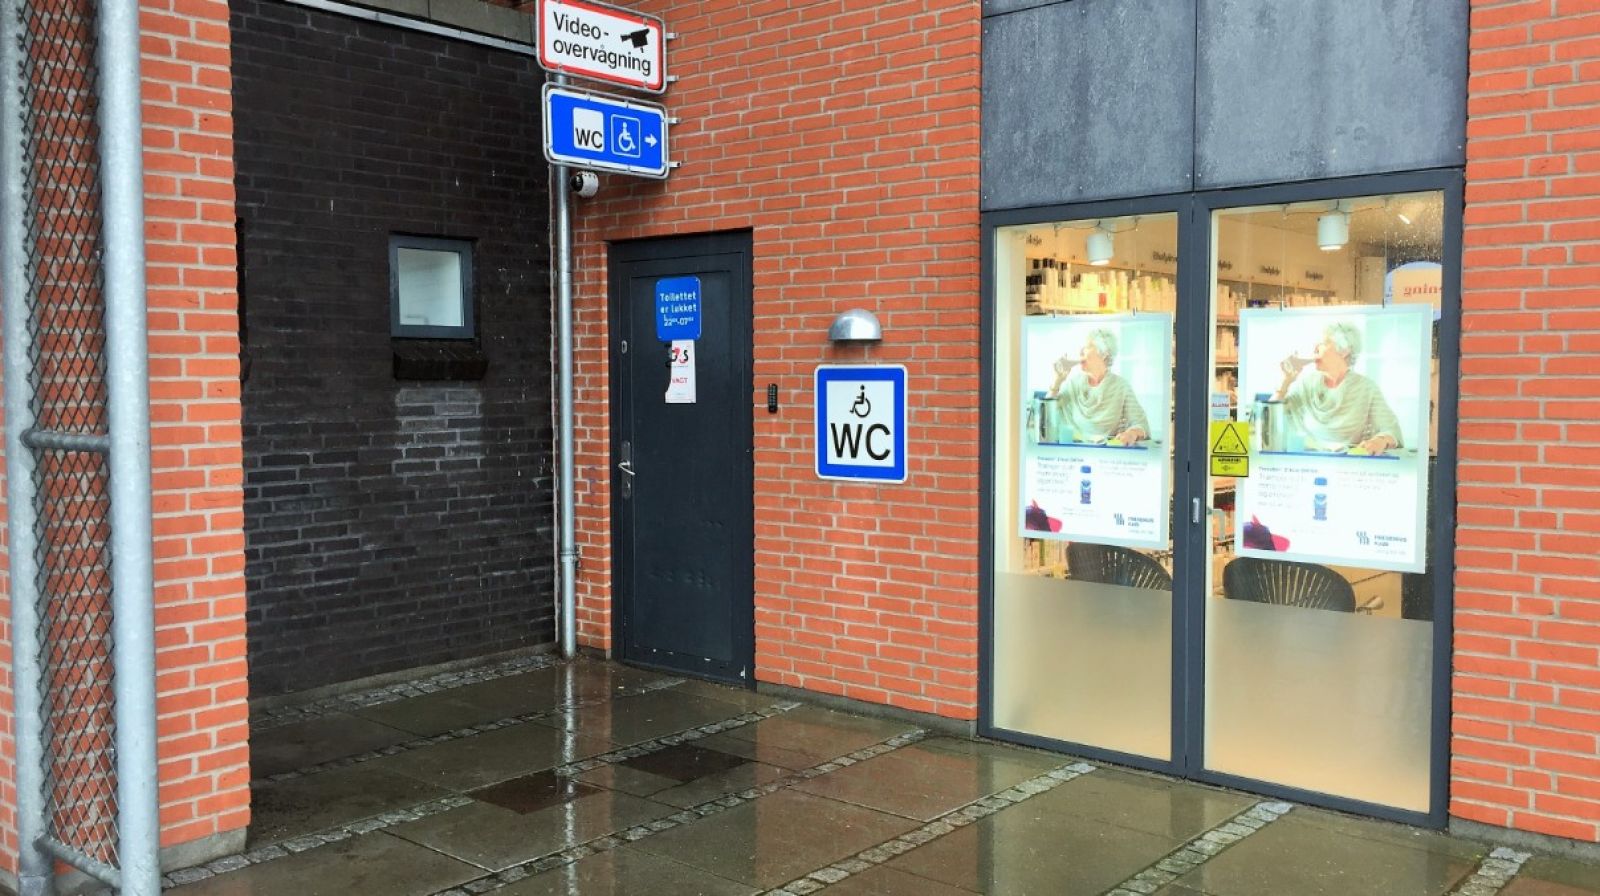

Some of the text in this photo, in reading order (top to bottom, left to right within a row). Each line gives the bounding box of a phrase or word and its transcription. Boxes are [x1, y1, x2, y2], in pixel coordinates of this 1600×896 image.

[553, 11, 609, 40] Video-
[553, 39, 651, 77] overvågning
[575, 127, 603, 149] WC
[660, 291, 697, 302] Toilettet
[660, 303, 697, 314] er lukket
[830, 422, 891, 460] WC
